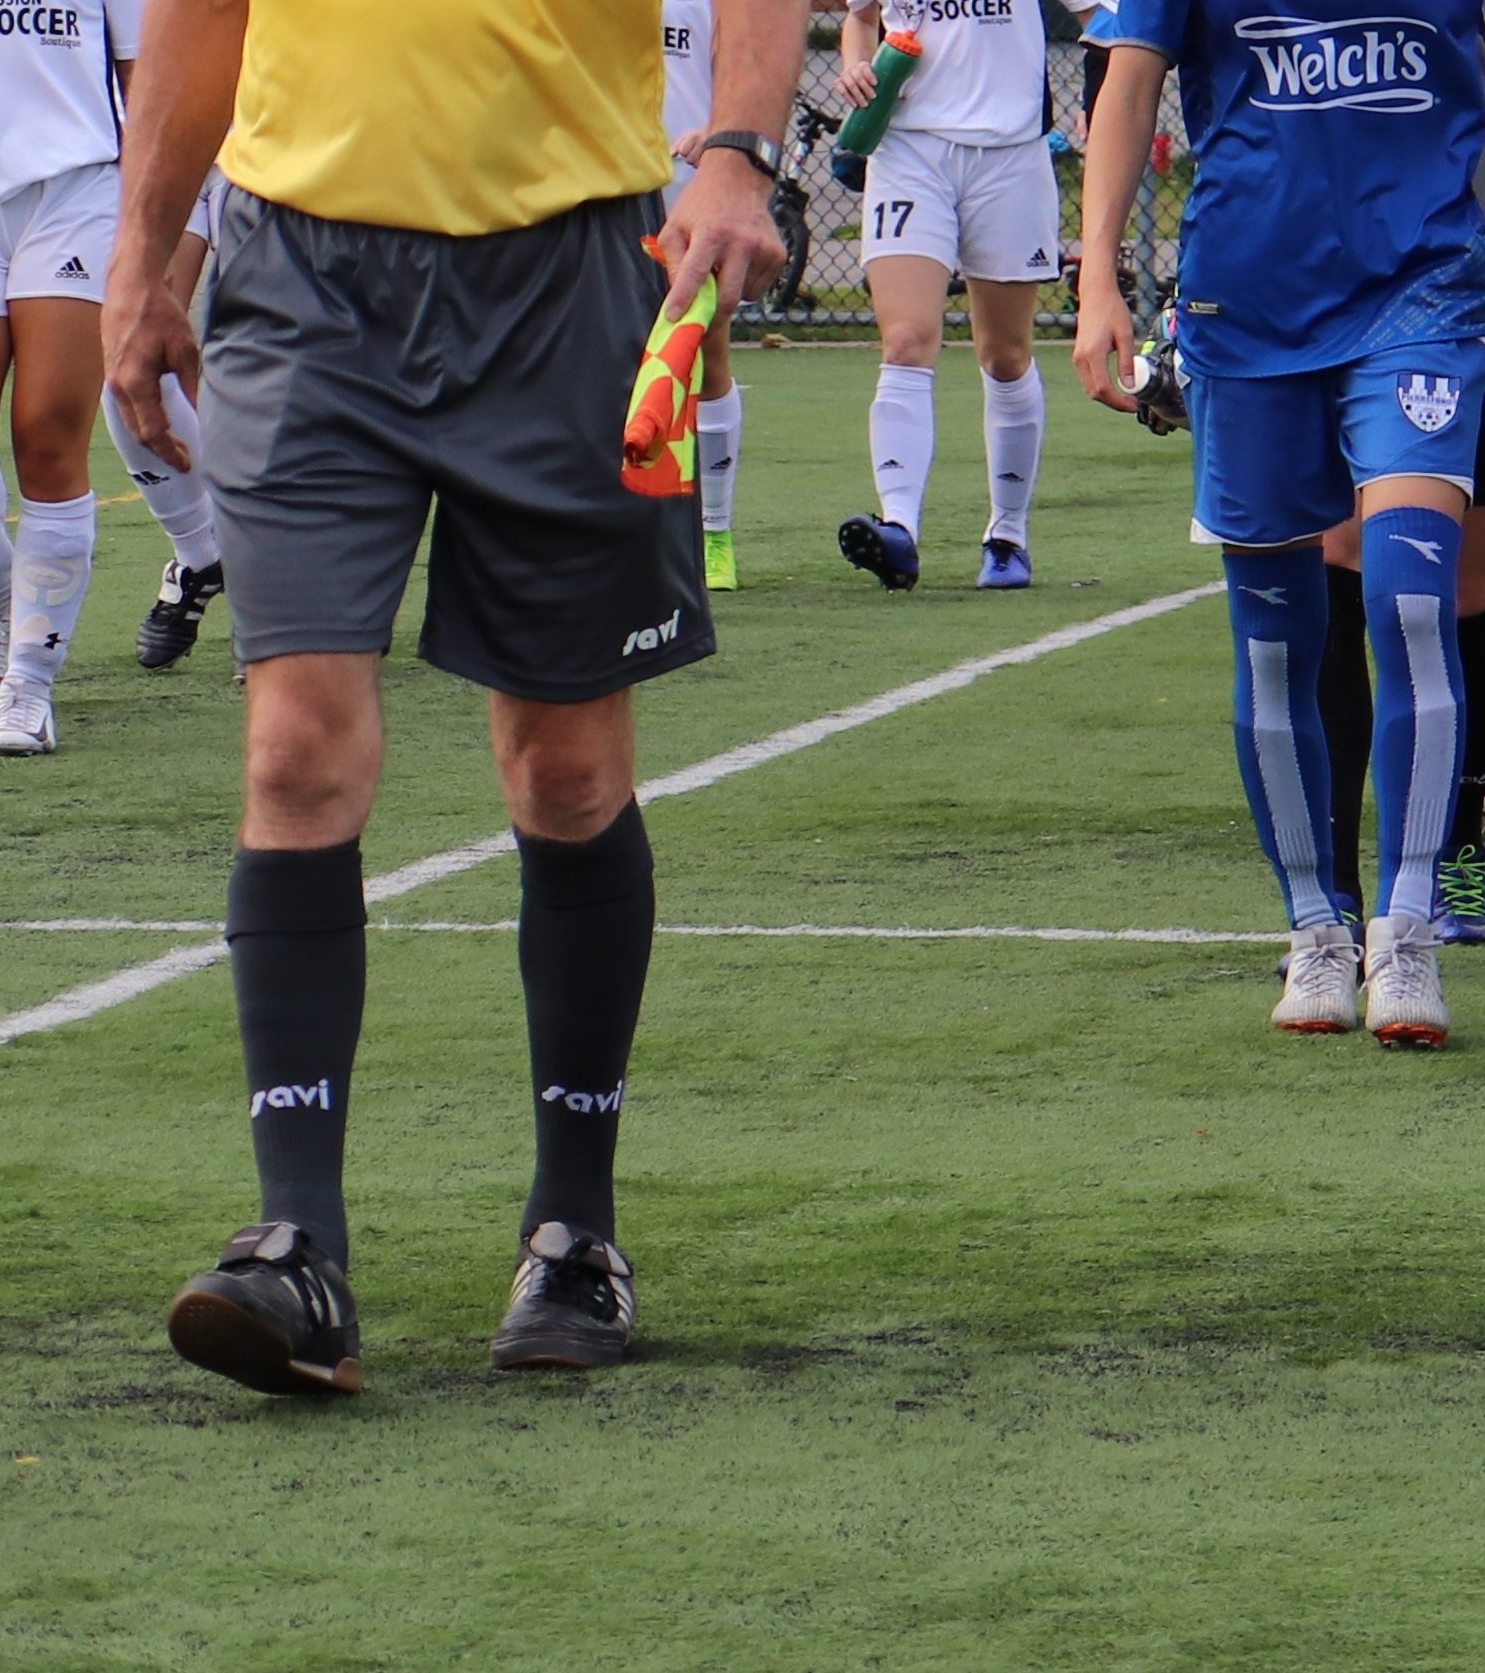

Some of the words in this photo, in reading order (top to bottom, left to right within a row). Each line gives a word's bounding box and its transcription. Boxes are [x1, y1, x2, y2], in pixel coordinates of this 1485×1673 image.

[1248, 30, 1428, 96] Welch's
[874, 201, 915, 240] 17
[54, 270, 90, 280] adidas
[622, 609, 680, 657] savi
[250, 1078, 330, 1119] savi
[541, 1079, 623, 1114] savi
